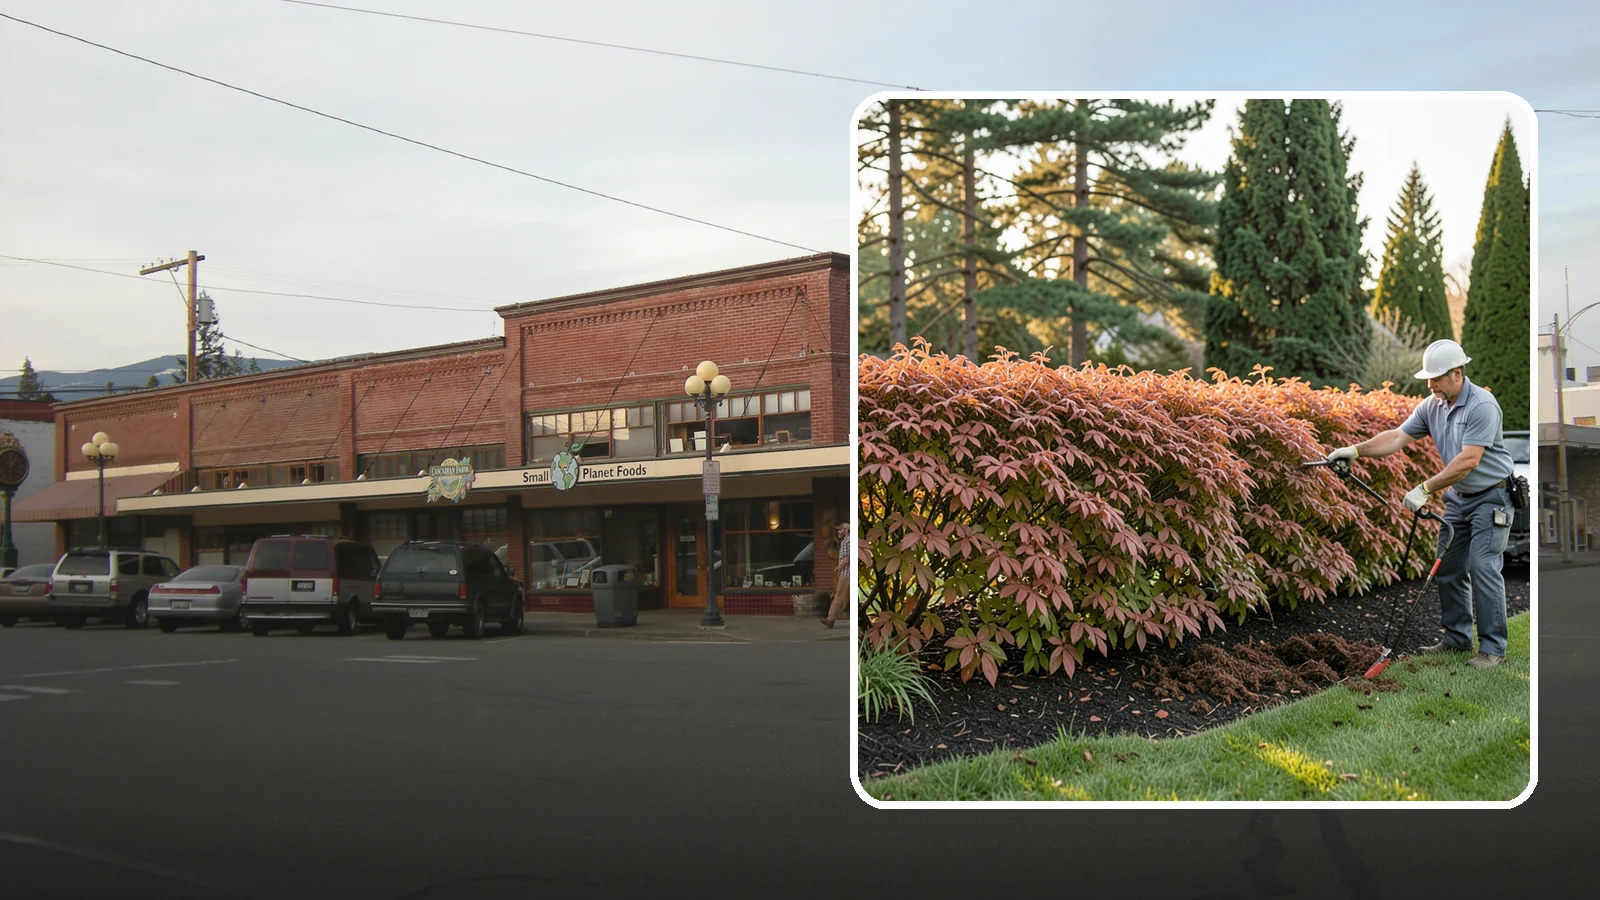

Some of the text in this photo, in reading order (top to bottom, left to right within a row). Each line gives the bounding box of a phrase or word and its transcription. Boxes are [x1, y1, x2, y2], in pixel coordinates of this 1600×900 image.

[523, 464, 647, 483] Small Planet Foods
